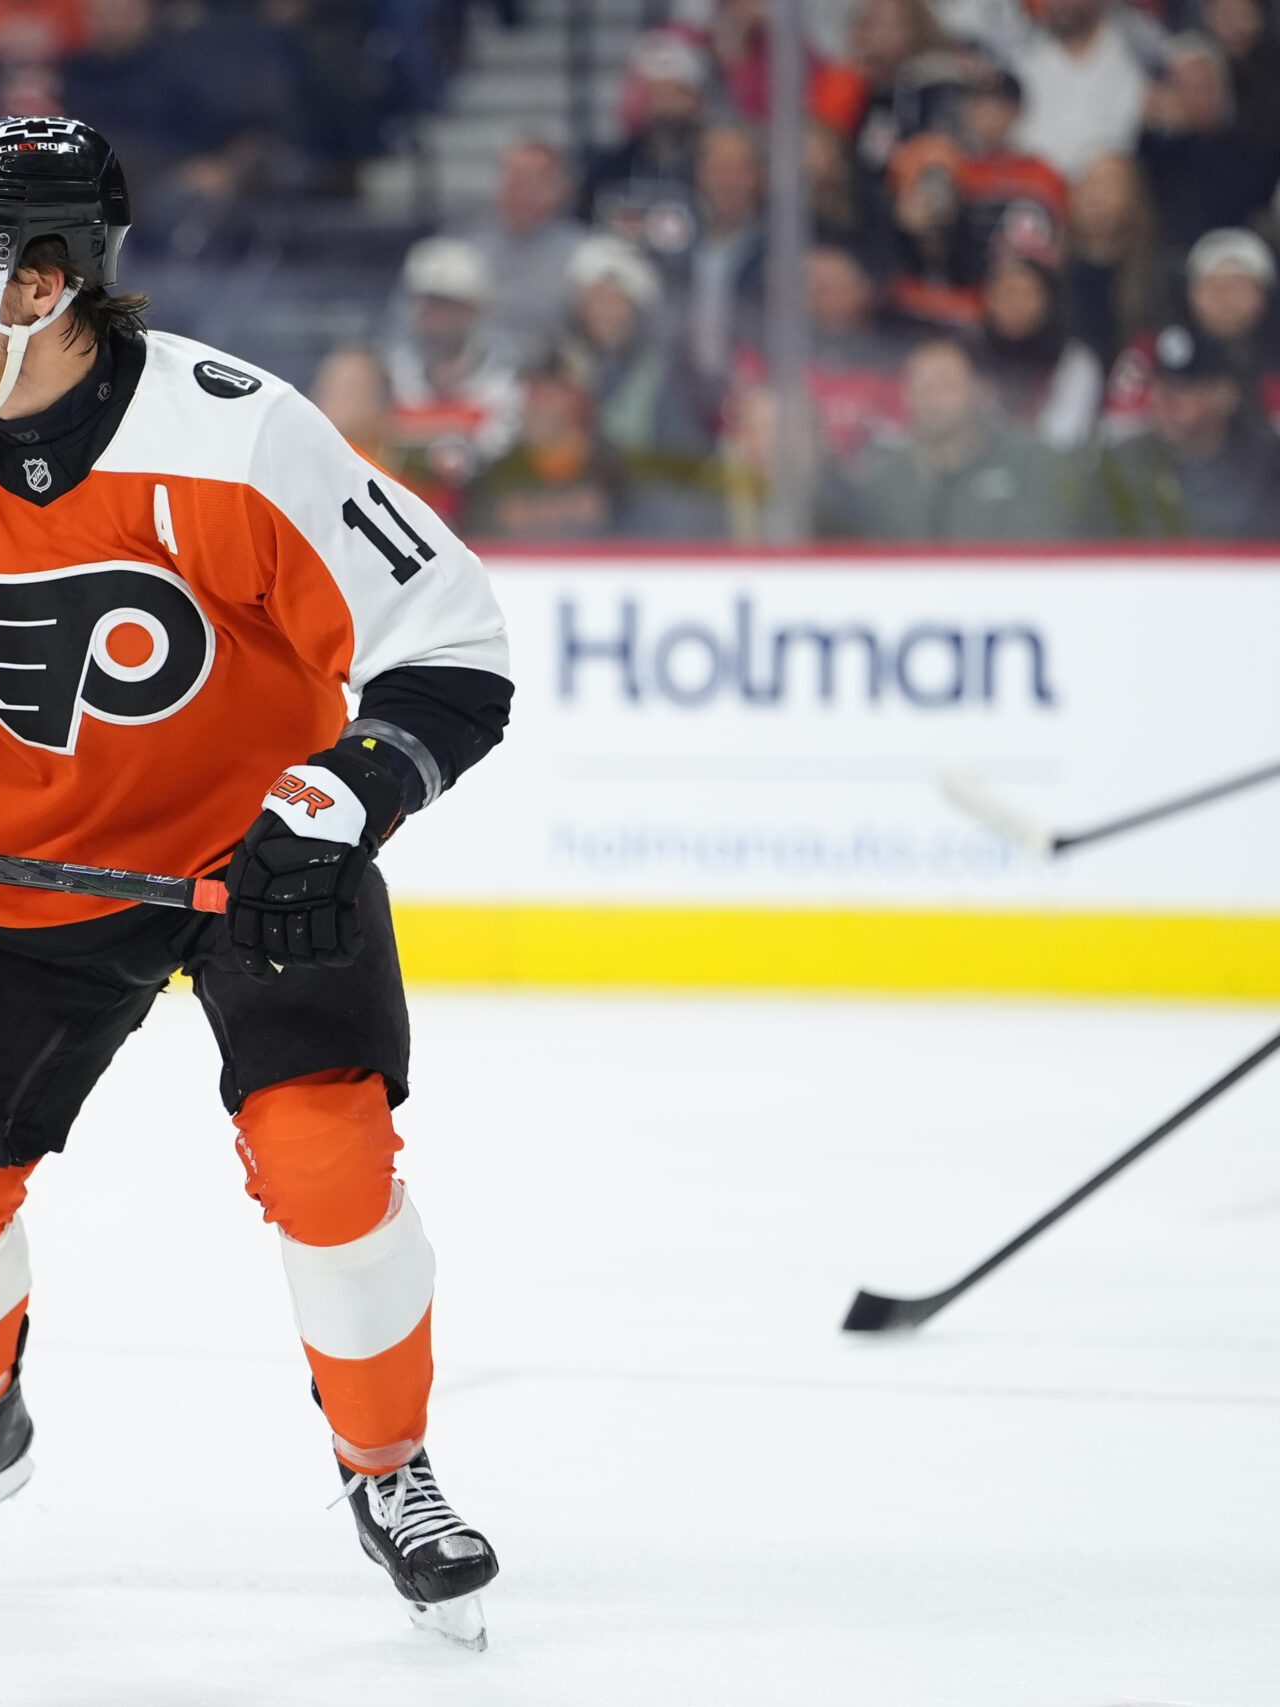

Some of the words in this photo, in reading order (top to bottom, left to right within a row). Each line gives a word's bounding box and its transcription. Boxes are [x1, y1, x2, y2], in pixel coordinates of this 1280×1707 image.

[153, 484, 179, 556] A
[342, 479, 437, 585] 11
[558, 594, 1058, 706] Holman
[270, 772, 335, 819] ER
